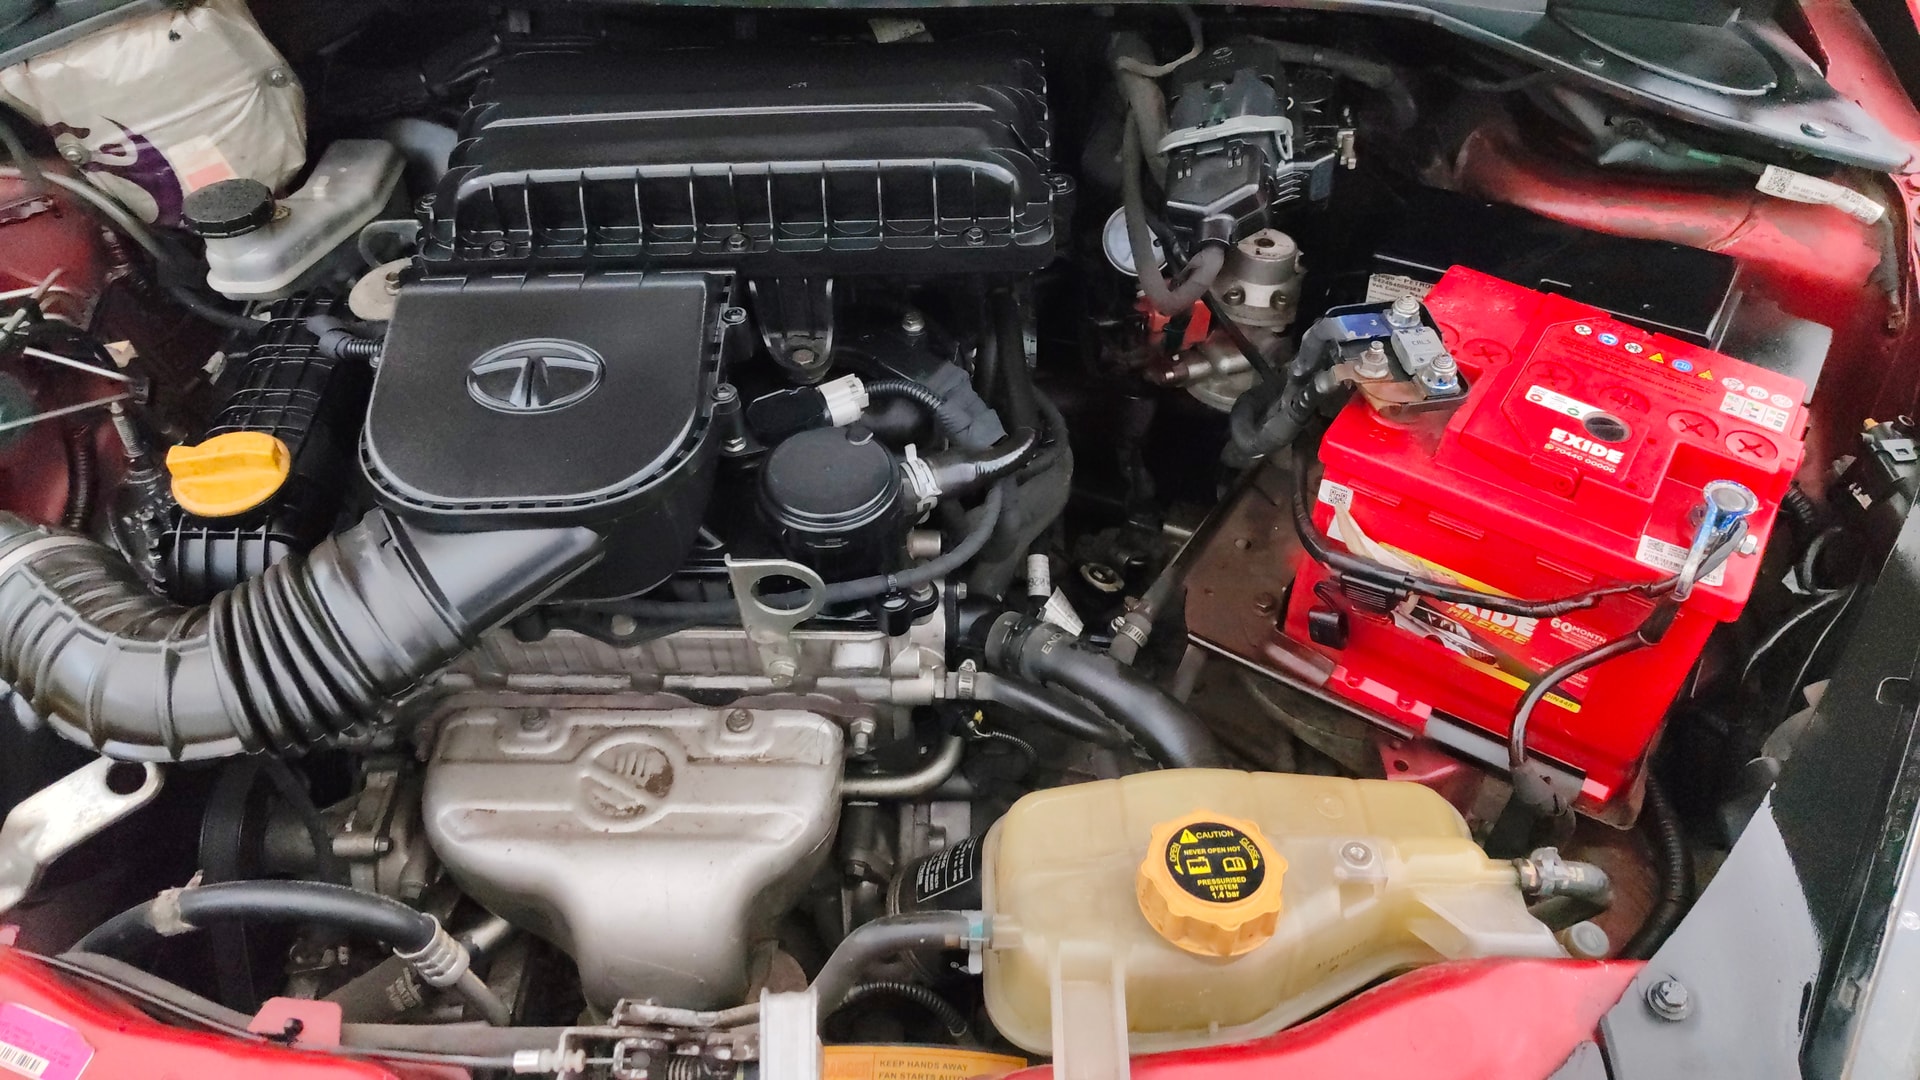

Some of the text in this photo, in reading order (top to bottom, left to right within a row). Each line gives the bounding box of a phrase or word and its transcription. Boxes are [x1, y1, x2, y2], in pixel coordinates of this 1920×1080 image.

[1549, 427, 1624, 464] EXIDE
[1554, 447, 1616, 473] 70440 00000
[1441, 601, 1540, 638] XIDE
[1446, 605, 1531, 645] MILEAGE
[1551, 618, 1572, 633] 60
[1572, 626, 1607, 644] MONTH
[1196, 830, 1234, 839] CAUTION
[1169, 842, 1181, 862] OPEN
[1184, 845, 1241, 856] NEVER OPEN HOT
[1239, 837, 1260, 860] CLOSE
[1197, 876, 1247, 886] PRESSURISED
[1209, 883, 1239, 892] SYSTEM
[1212, 890, 1240, 899] 1.4 bar
[880, 1060, 968, 1071] KEEP HANDS AWAY
[878, 1071, 897, 1080] FAN
[899, 1072, 936, 1080] STARTS
